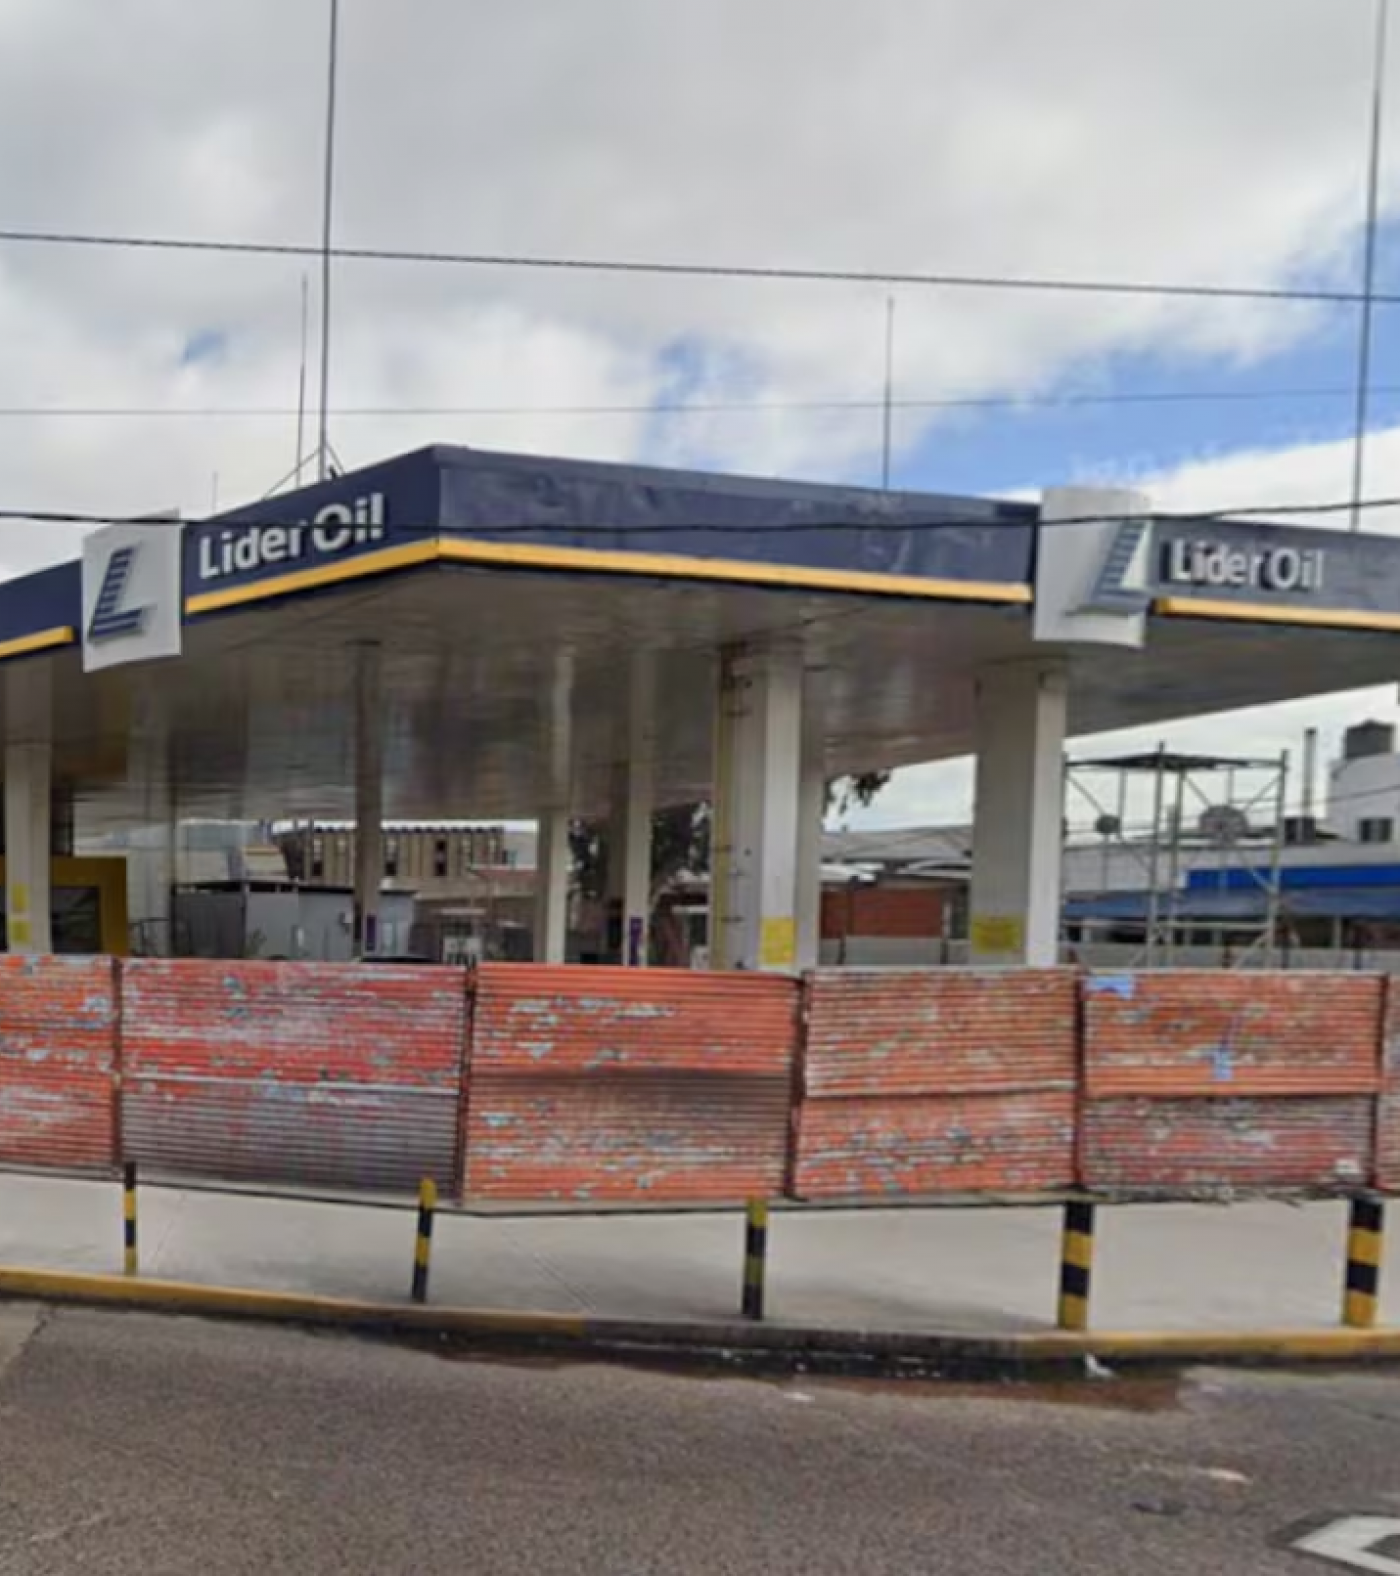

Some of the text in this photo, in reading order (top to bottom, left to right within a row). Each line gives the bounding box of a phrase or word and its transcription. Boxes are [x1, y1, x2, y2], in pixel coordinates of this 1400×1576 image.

[200, 493, 385, 578] Lider Oil
[1169, 538, 1323, 590] Lider Oil
